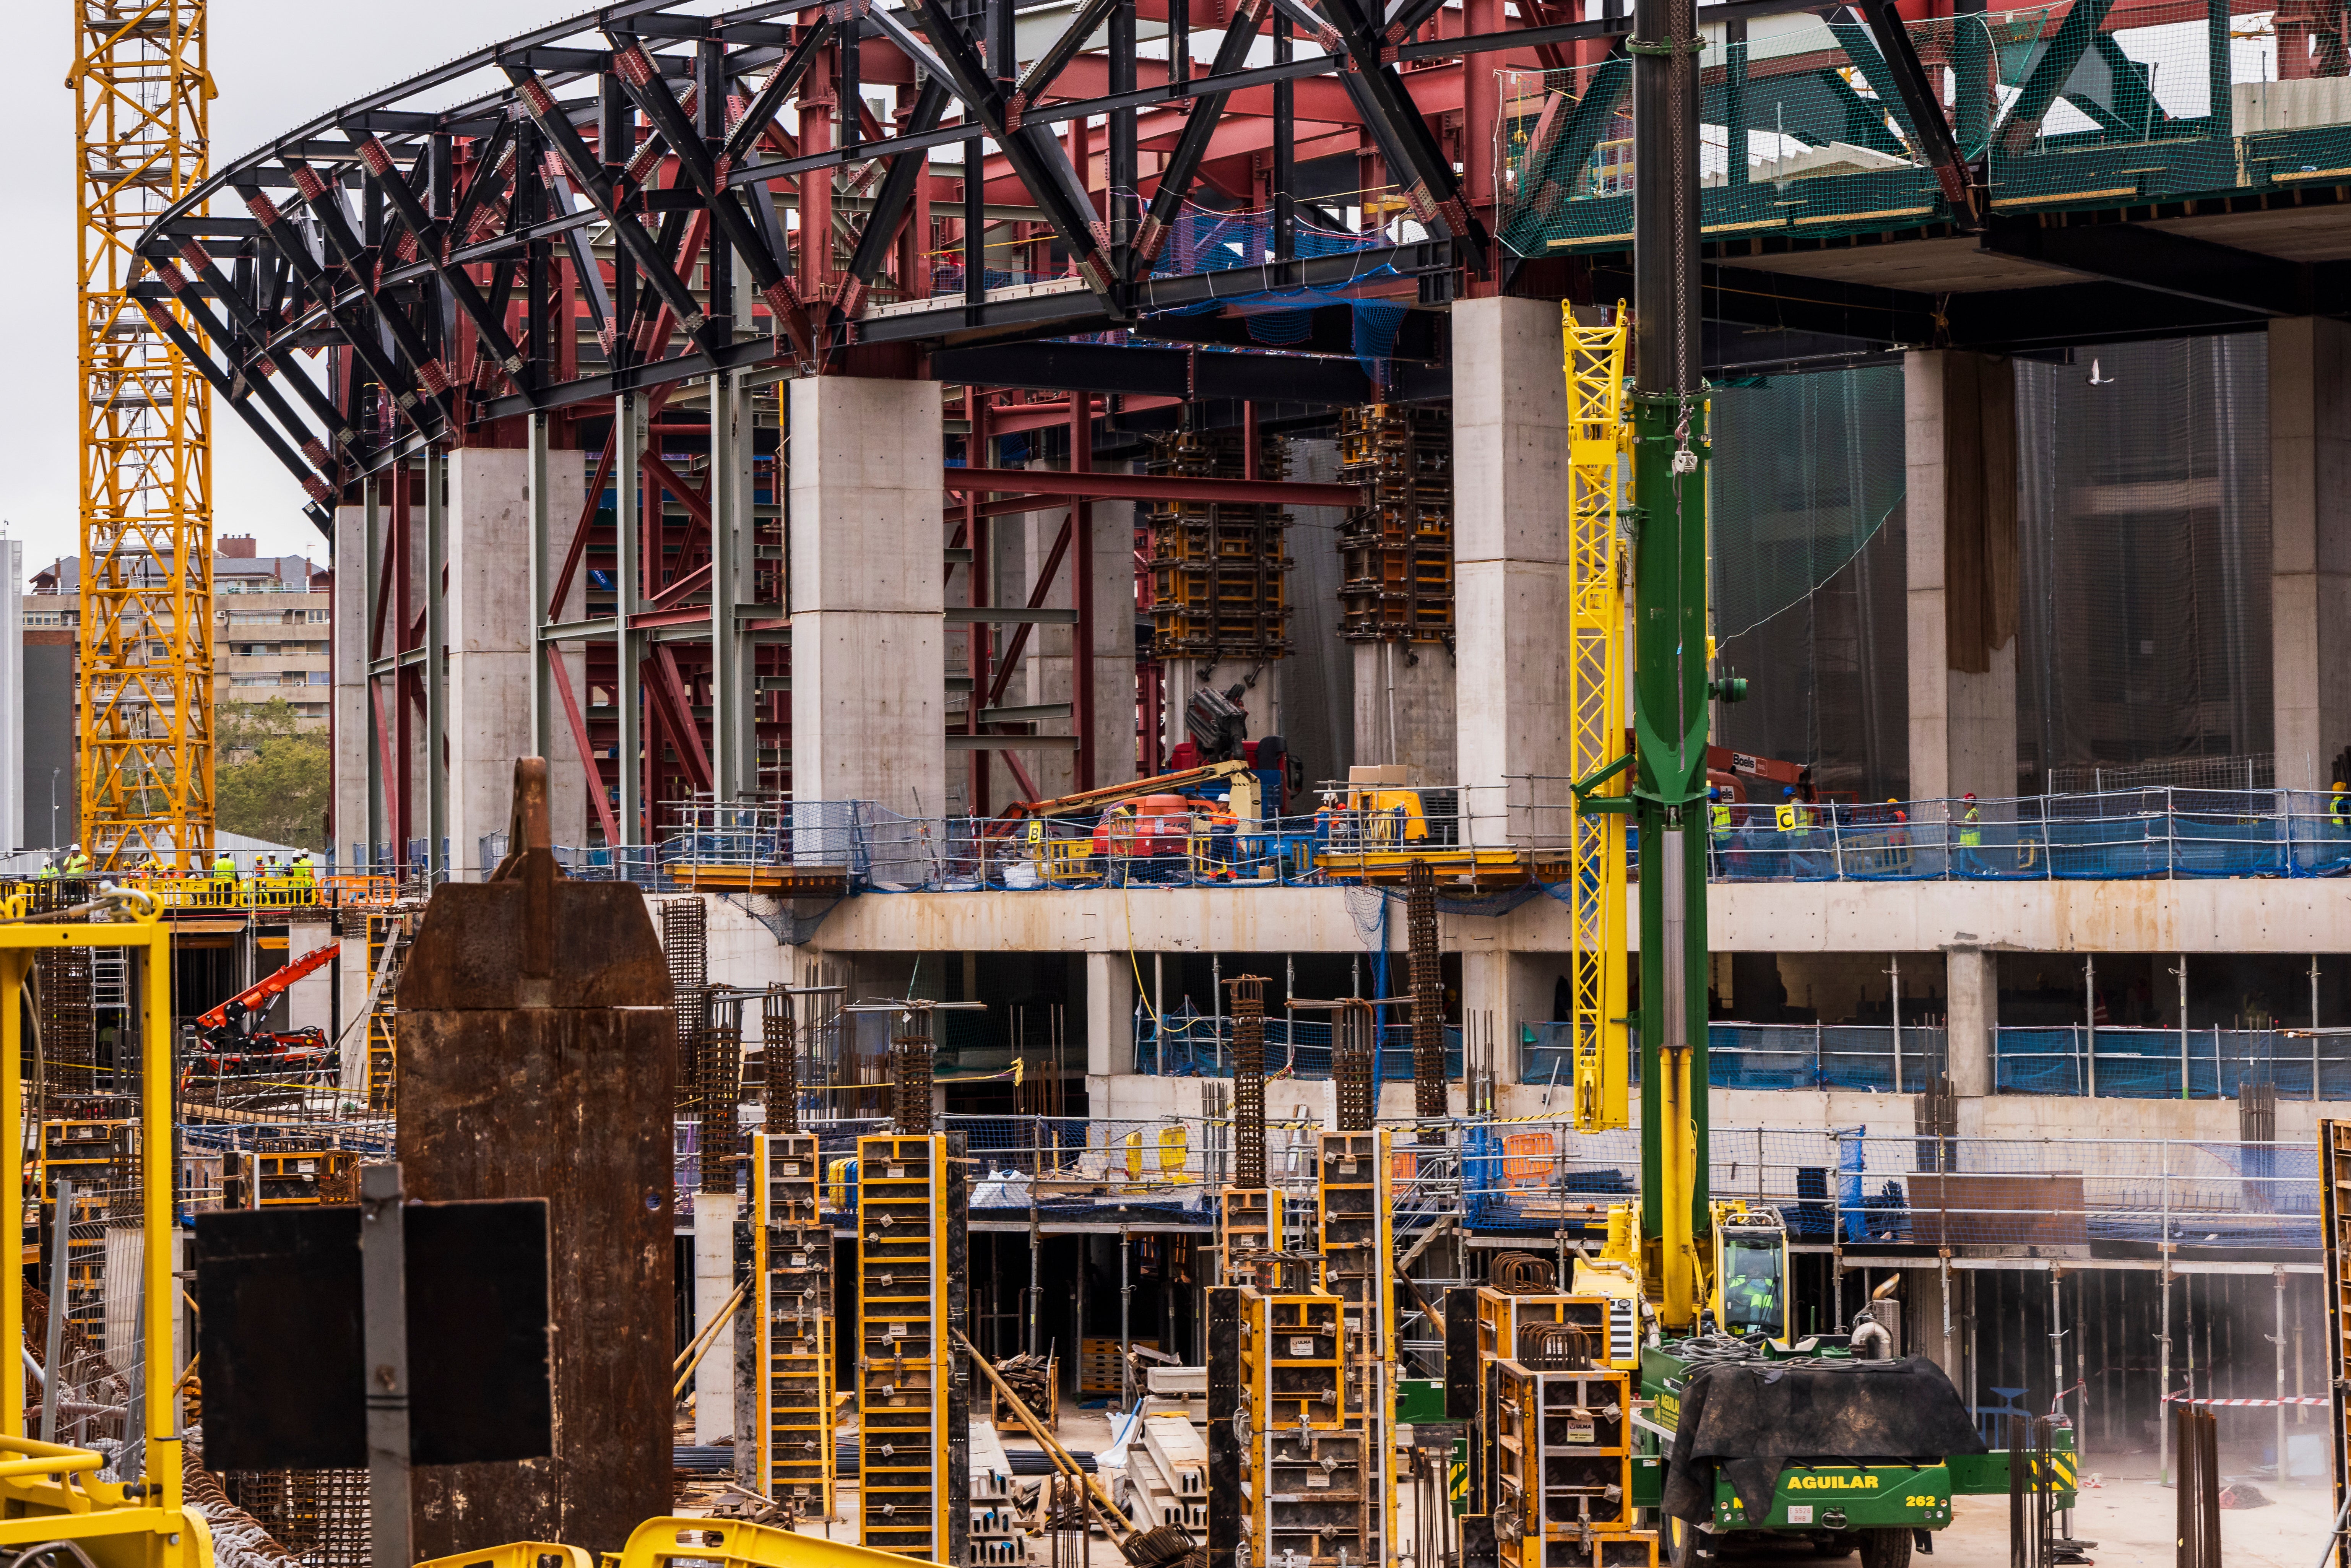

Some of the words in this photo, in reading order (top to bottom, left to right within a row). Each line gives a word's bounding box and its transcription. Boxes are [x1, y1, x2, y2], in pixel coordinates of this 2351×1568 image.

[1733, 754, 1754, 769] Boels
[1780, 812, 1793, 828] C
[1031, 828, 1038, 841] B
[1787, 1476, 1879, 1489] AGUILAR
[1906, 1496, 1935, 1507] 262
